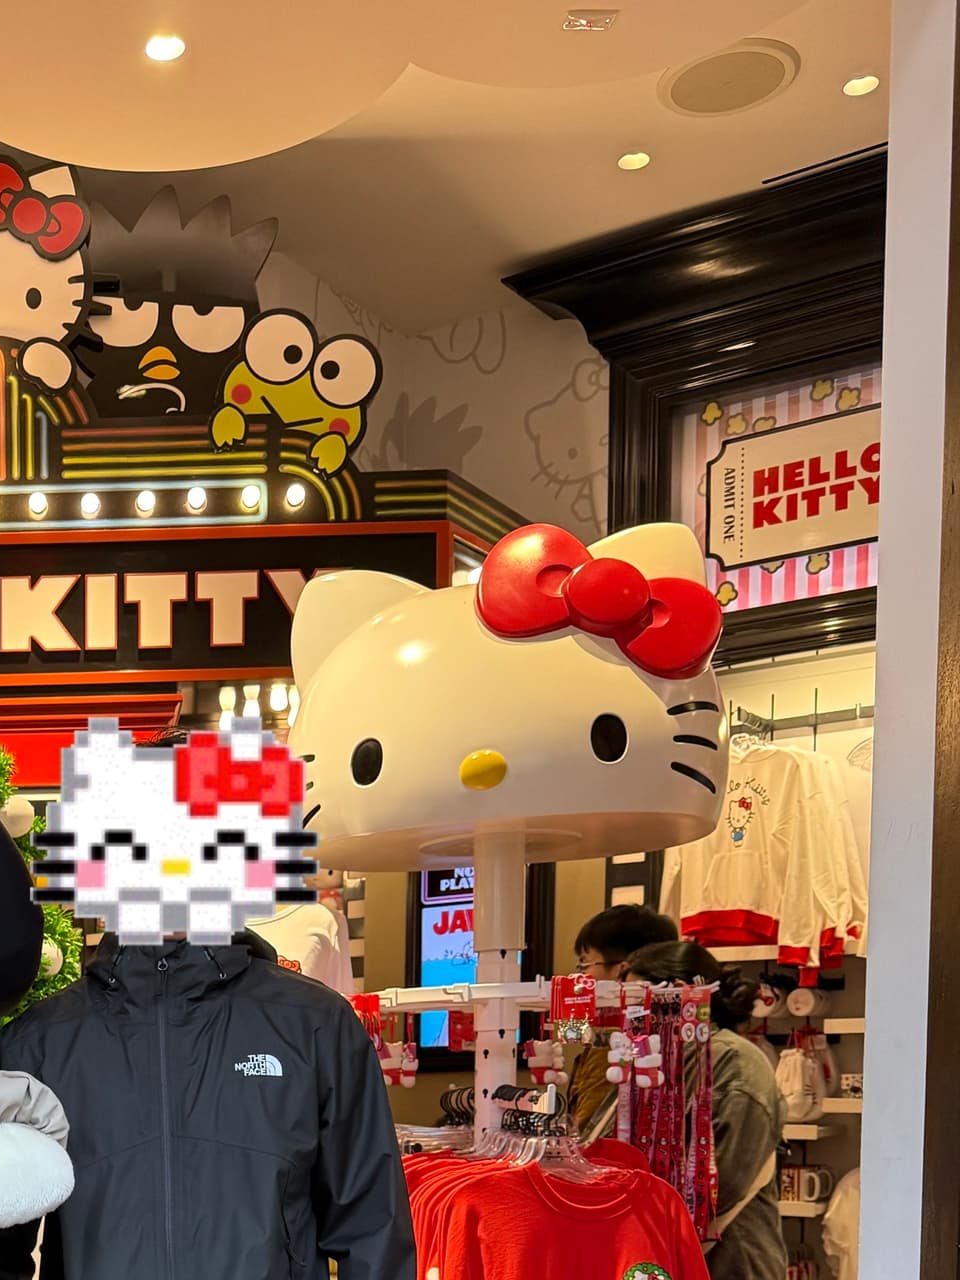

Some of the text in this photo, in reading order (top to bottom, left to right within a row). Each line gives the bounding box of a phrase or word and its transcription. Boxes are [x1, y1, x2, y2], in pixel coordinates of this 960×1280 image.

[752, 442, 880, 498] HELLO
[723, 467, 736, 544] ADMIT ONE
[752, 475, 880, 529] KITTY
[234, 1061, 266, 1071] NORTH
[243, 1069, 267, 1077] FACE
[247, 1054, 266, 1062] THE
